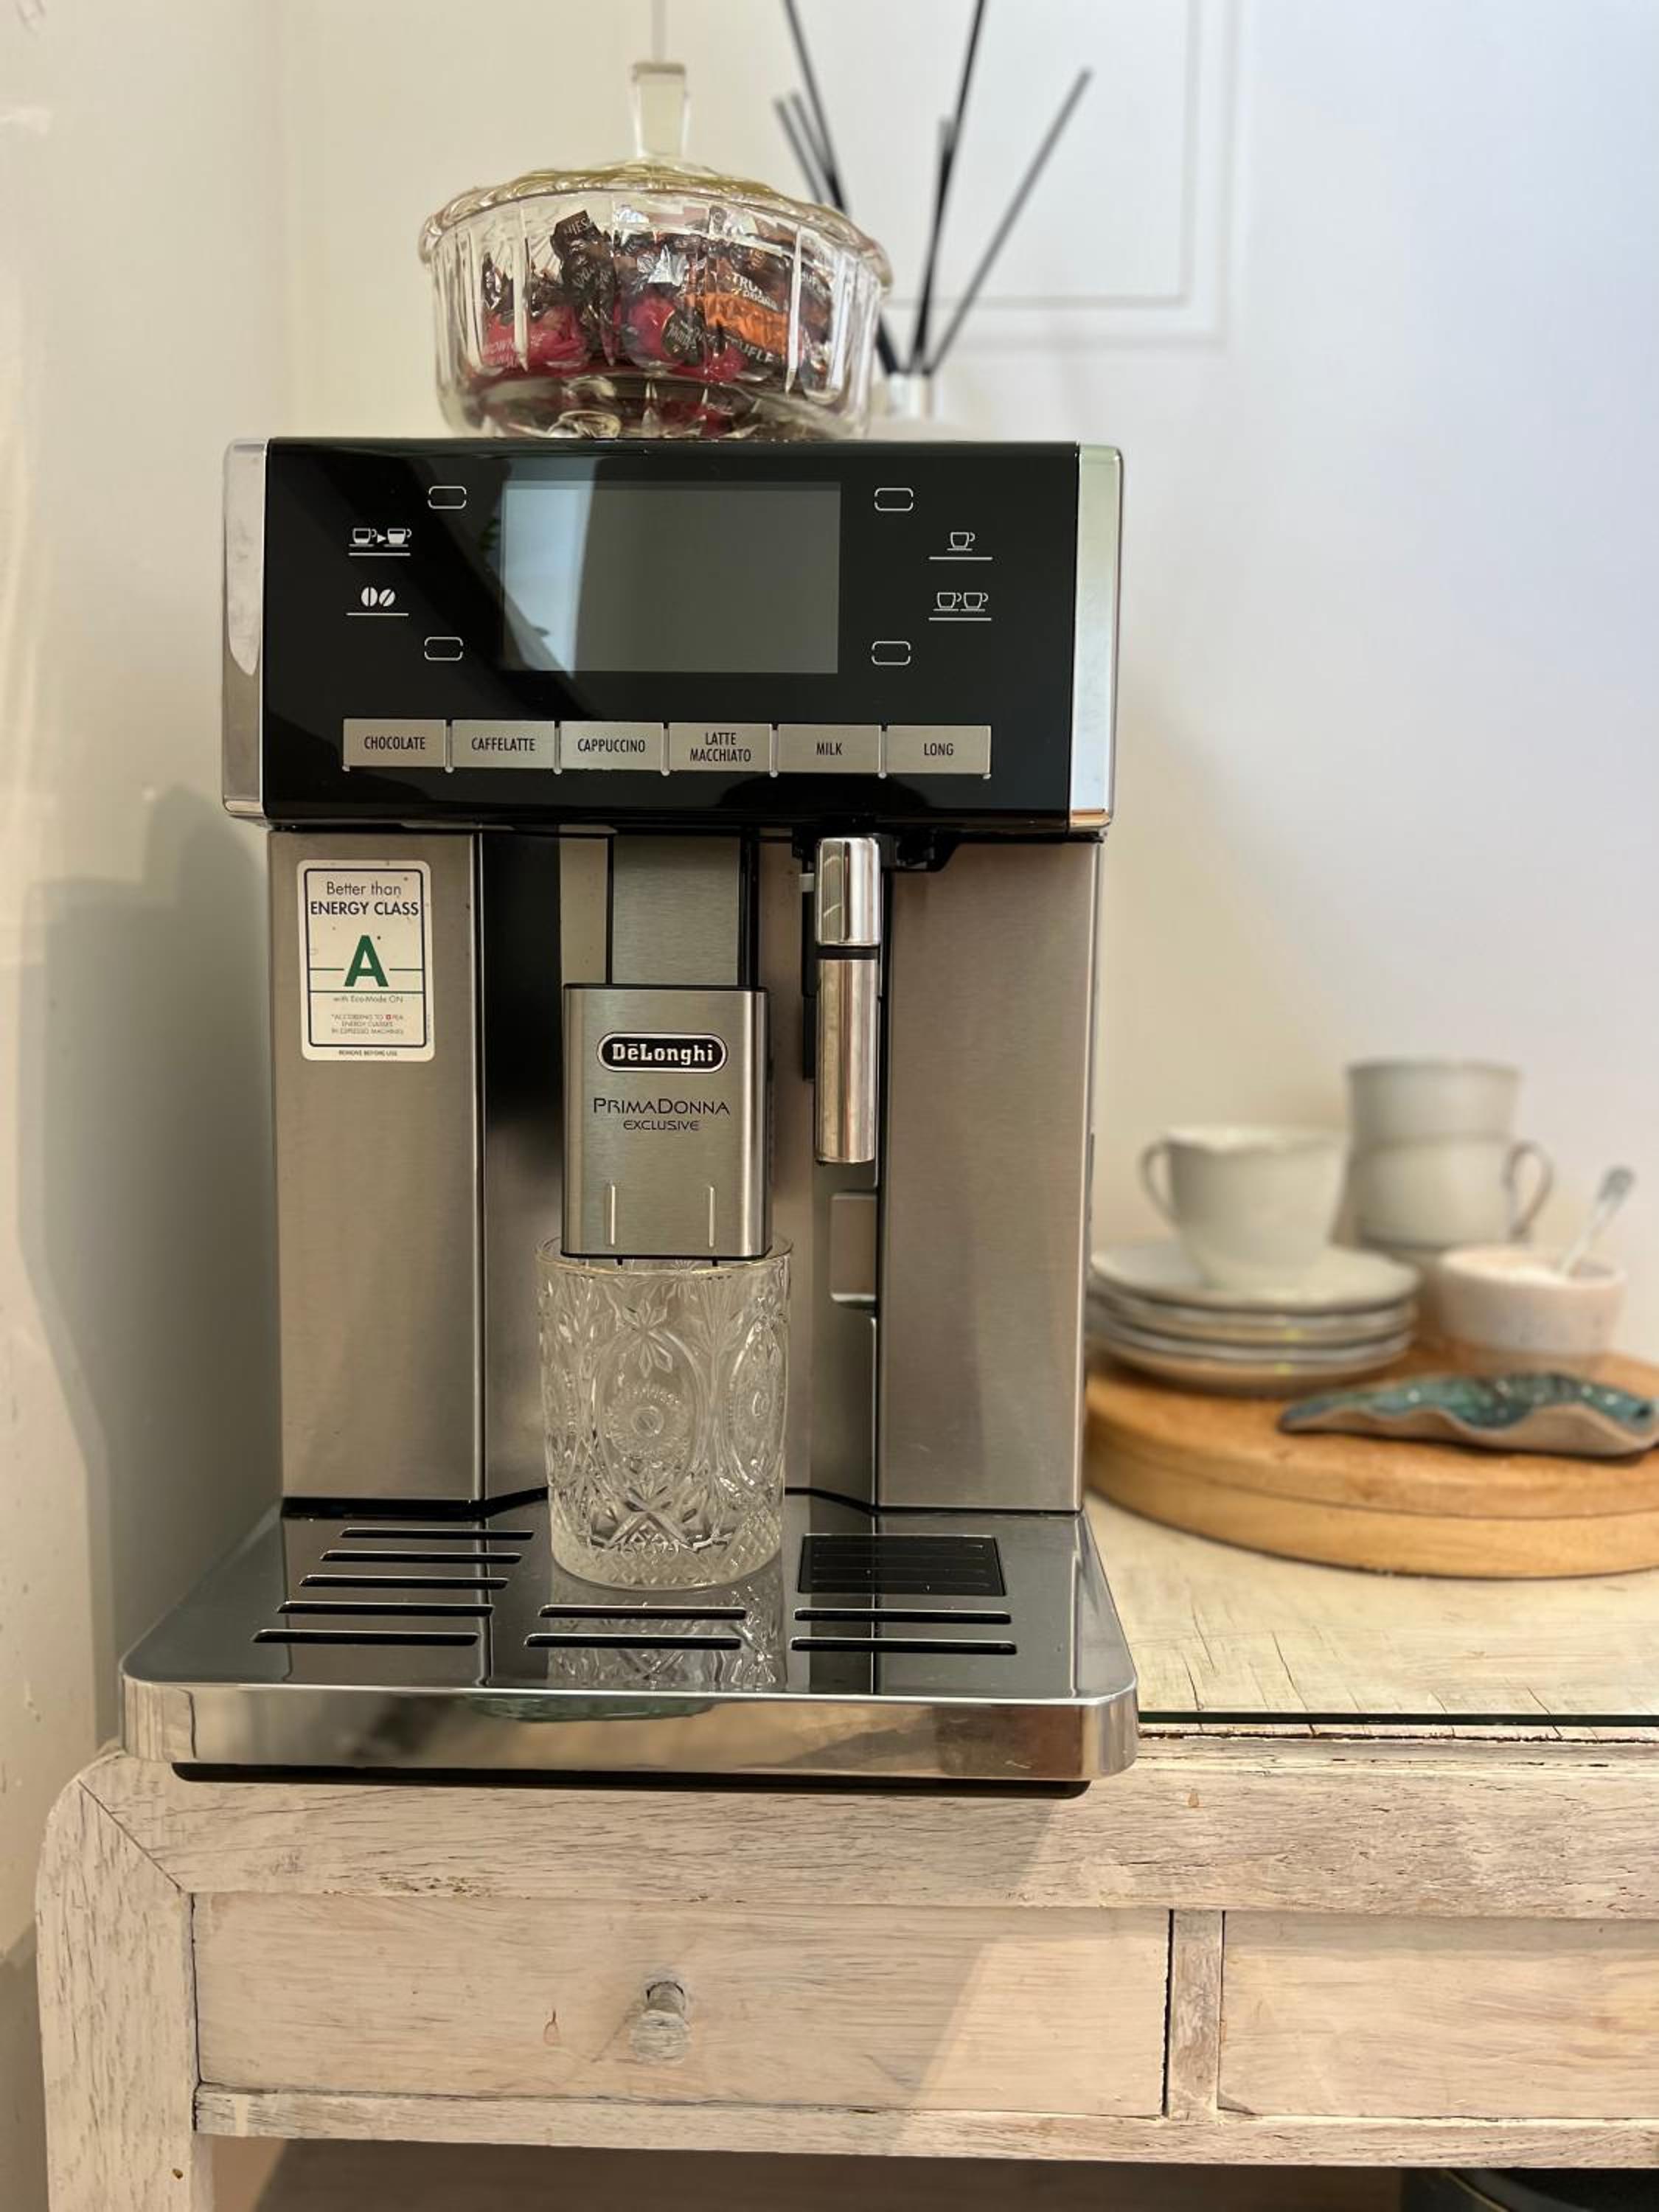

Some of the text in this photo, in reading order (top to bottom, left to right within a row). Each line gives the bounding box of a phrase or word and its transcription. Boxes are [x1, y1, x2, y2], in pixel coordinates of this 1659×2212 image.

[364, 737, 426, 751] CHOCOLATE
[471, 737, 536, 752] CAFFELATTE
[577, 738, 646, 754] CAPPUCCINO
[705, 732, 737, 746] LATTE
[689, 748, 751, 762] MACCHIATO
[816, 743, 843, 757] MILK
[923, 743, 954, 757] LONG
[327, 881, 401, 896] Better than
[310, 901, 419, 916] ENERGY CLASS
[344, 935, 389, 987] A
[623, 1120, 700, 1131] EXCLUSIVE
